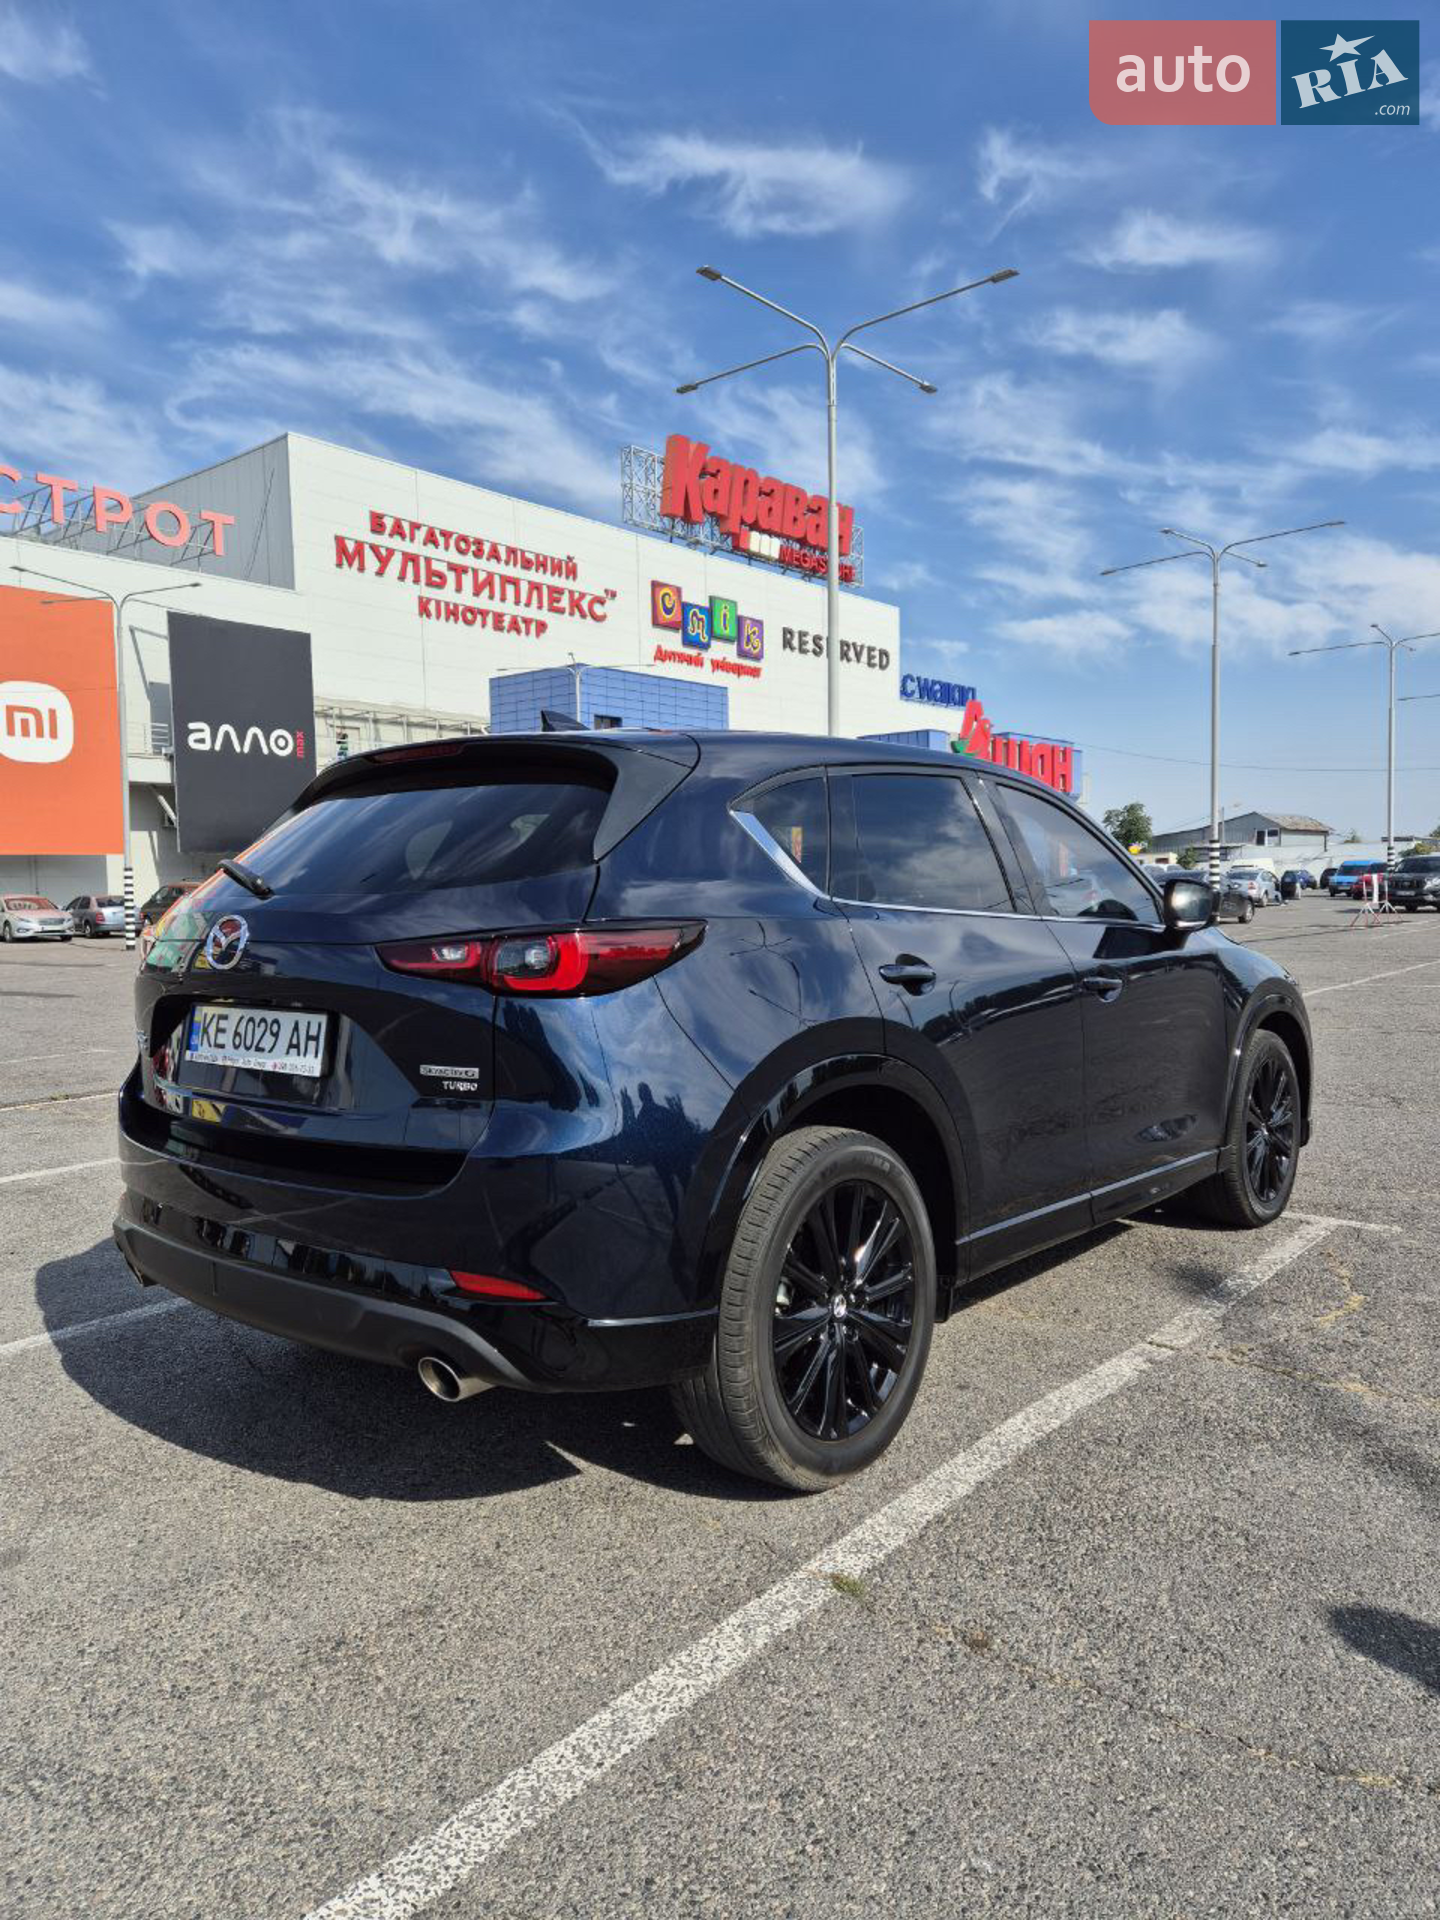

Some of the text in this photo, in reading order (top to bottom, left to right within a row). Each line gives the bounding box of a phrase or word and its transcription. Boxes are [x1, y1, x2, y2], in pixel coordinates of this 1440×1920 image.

[660, 434, 855, 557] Караван
[369, 510, 578, 581] БАГАТОЗАЛЬНИЙ
[334, 534, 607, 622] МУЛЬТИПЛЕКС
[417, 595, 548, 638] КІНОТЕАТР
[782, 626, 891, 671] RESRVED
[200, 1012, 322, 1059] KE 6029 AH
[442, 1081, 478, 1092] TURBO
